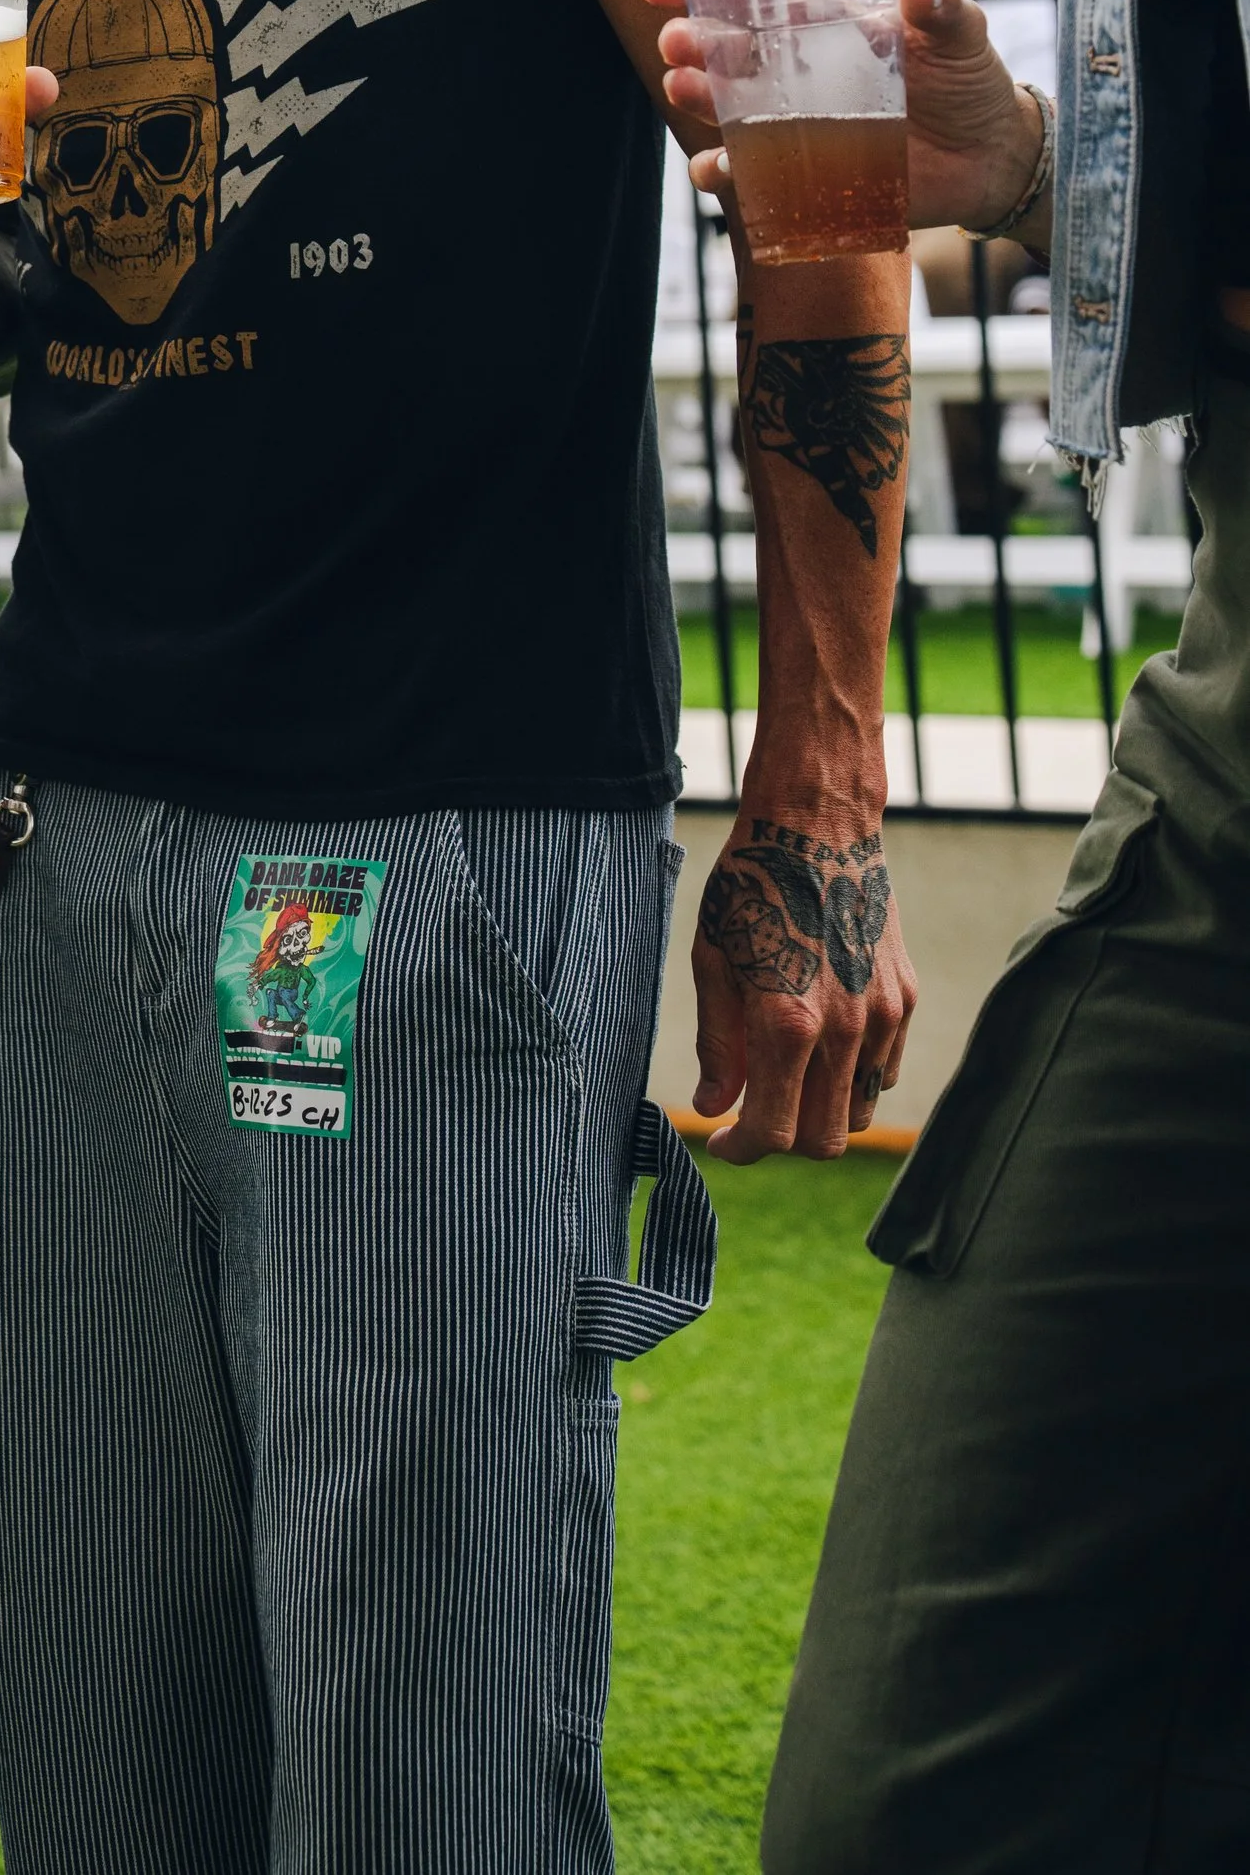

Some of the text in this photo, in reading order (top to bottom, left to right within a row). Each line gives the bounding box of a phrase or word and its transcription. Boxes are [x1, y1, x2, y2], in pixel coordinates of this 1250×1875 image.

[290, 233, 374, 279] 1903
[47, 340, 147, 386] WORLD'S
[250, 860, 368, 890] DANK DAZE
[244, 887, 364, 917] OF SUMMER
[306, 1034, 341, 1059] VIP
[301, 1106, 339, 1131] CH
